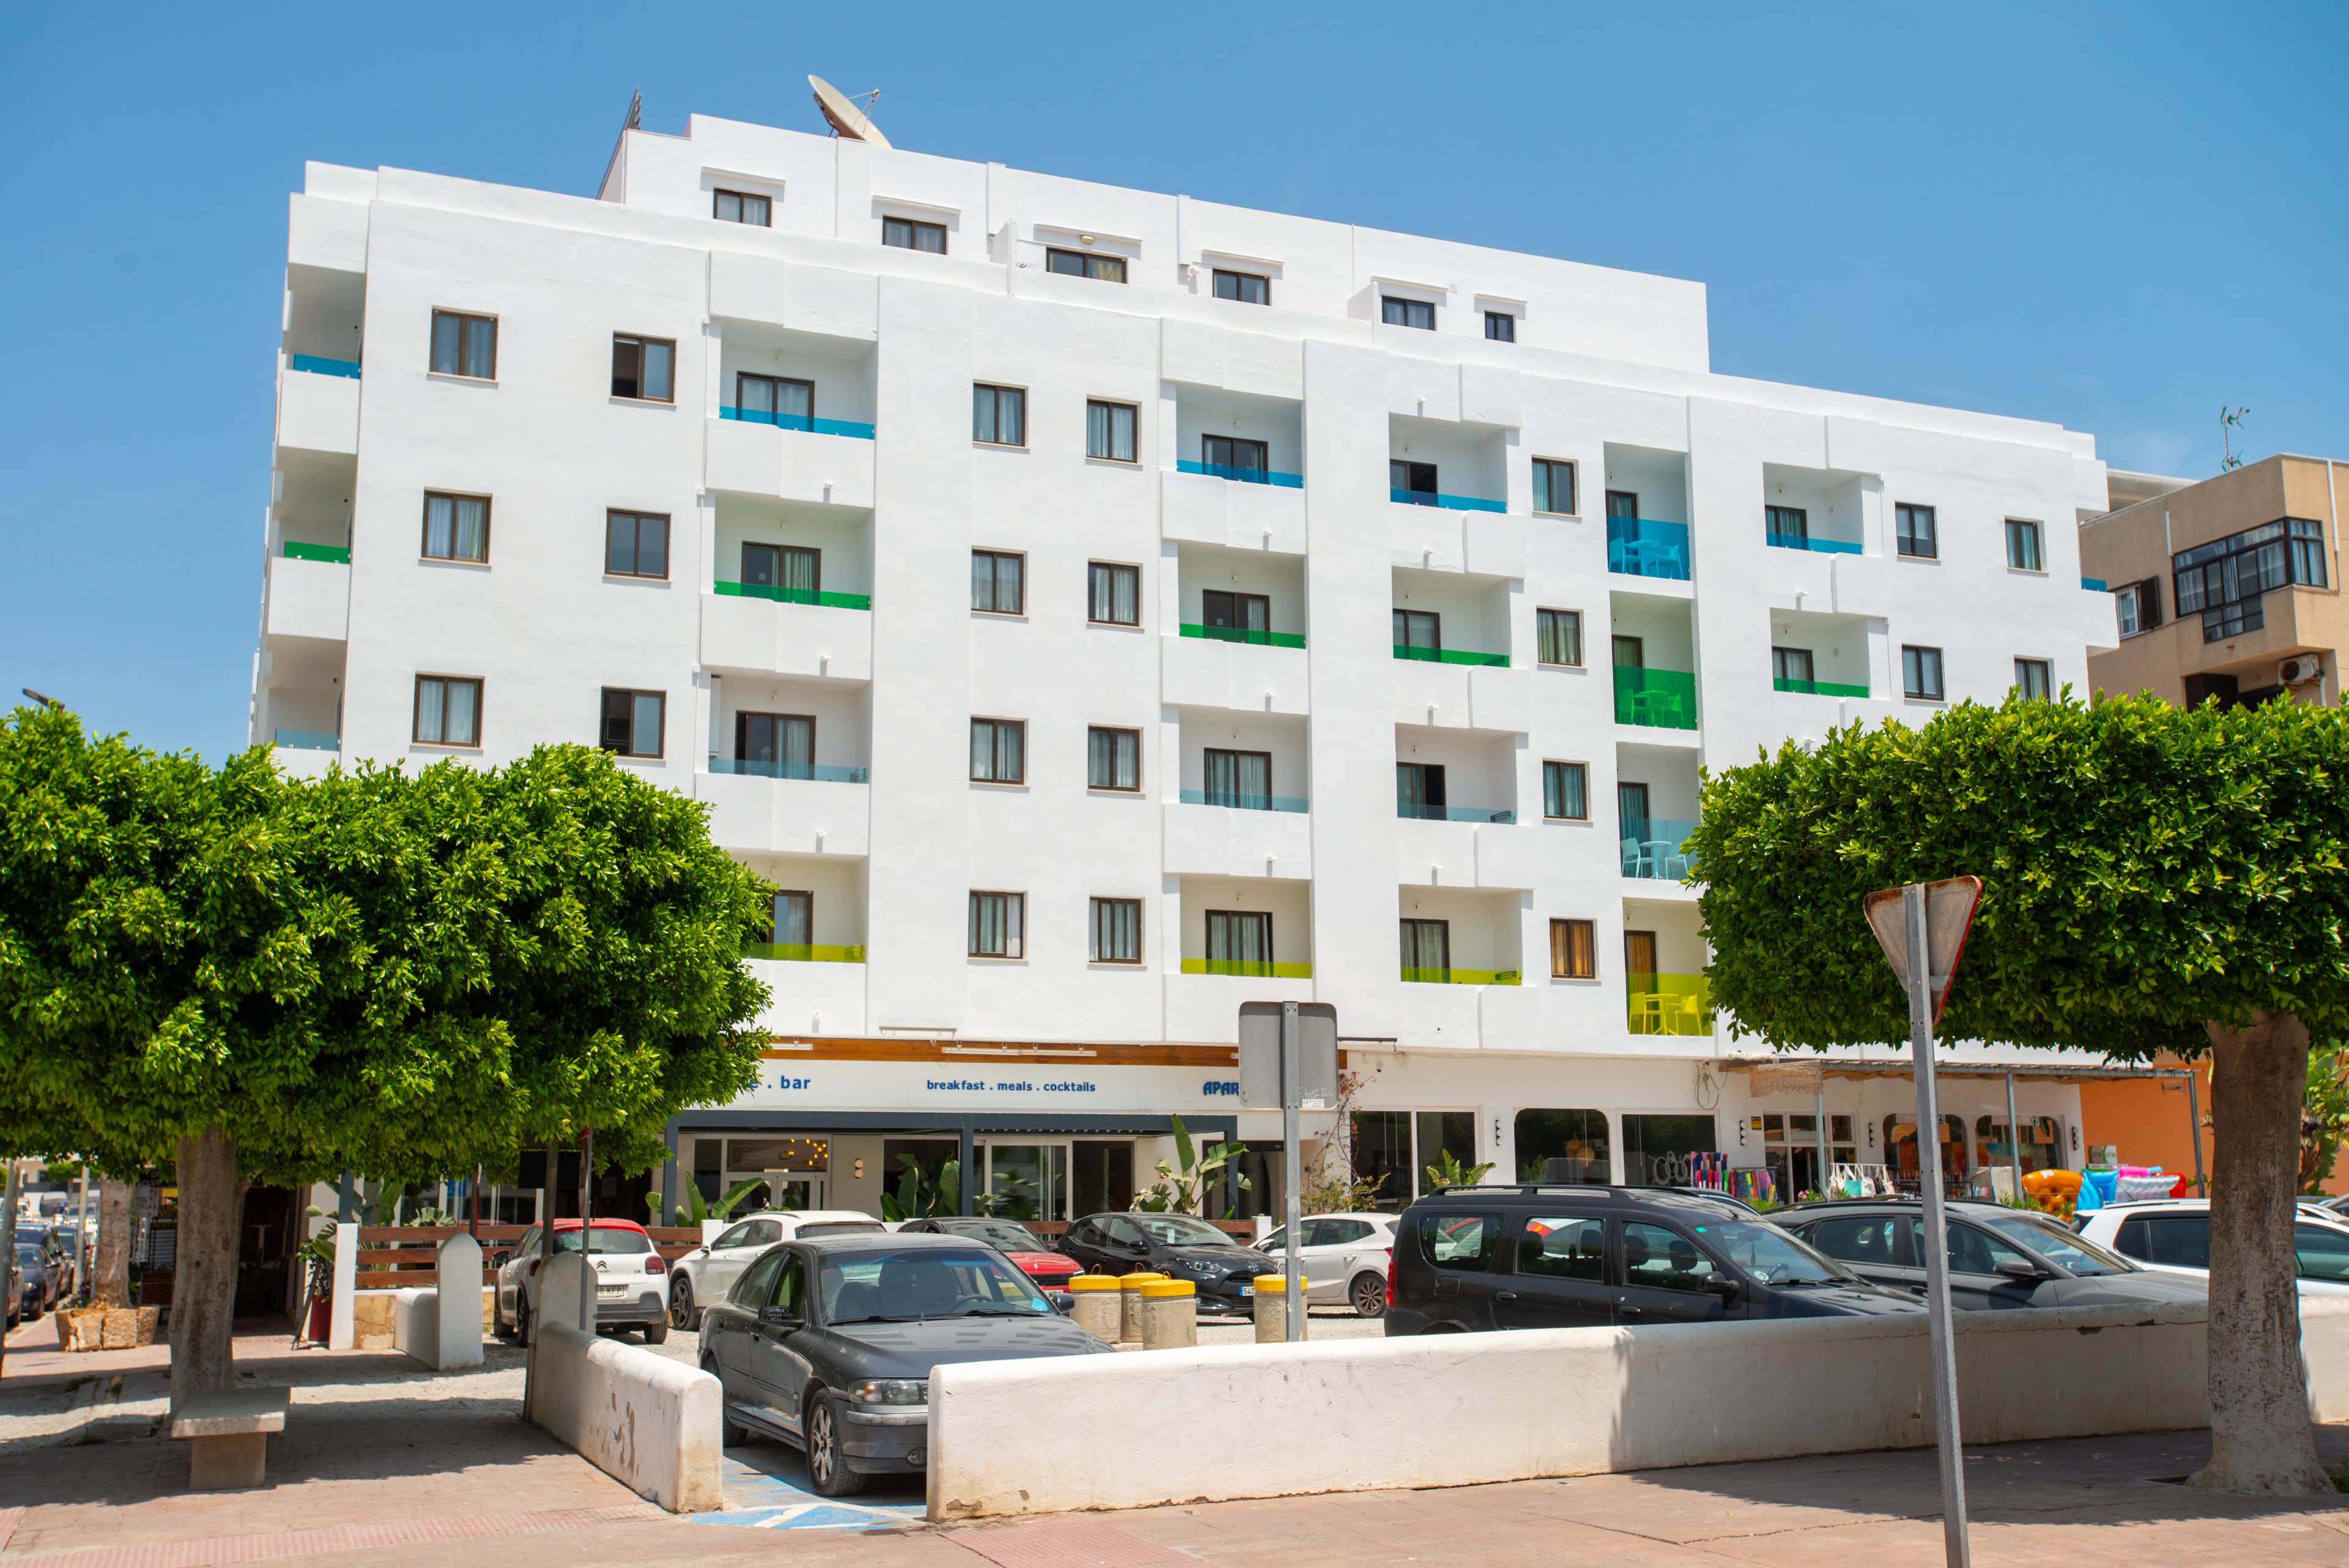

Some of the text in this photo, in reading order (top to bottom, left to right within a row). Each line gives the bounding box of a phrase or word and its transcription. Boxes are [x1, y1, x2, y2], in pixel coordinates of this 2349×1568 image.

[781, 1076, 811, 1089] bar
[927, 1080, 985, 1090] breakfast
[997, 1081, 1033, 1091] meals
[1044, 1082, 1096, 1092] cocktails
